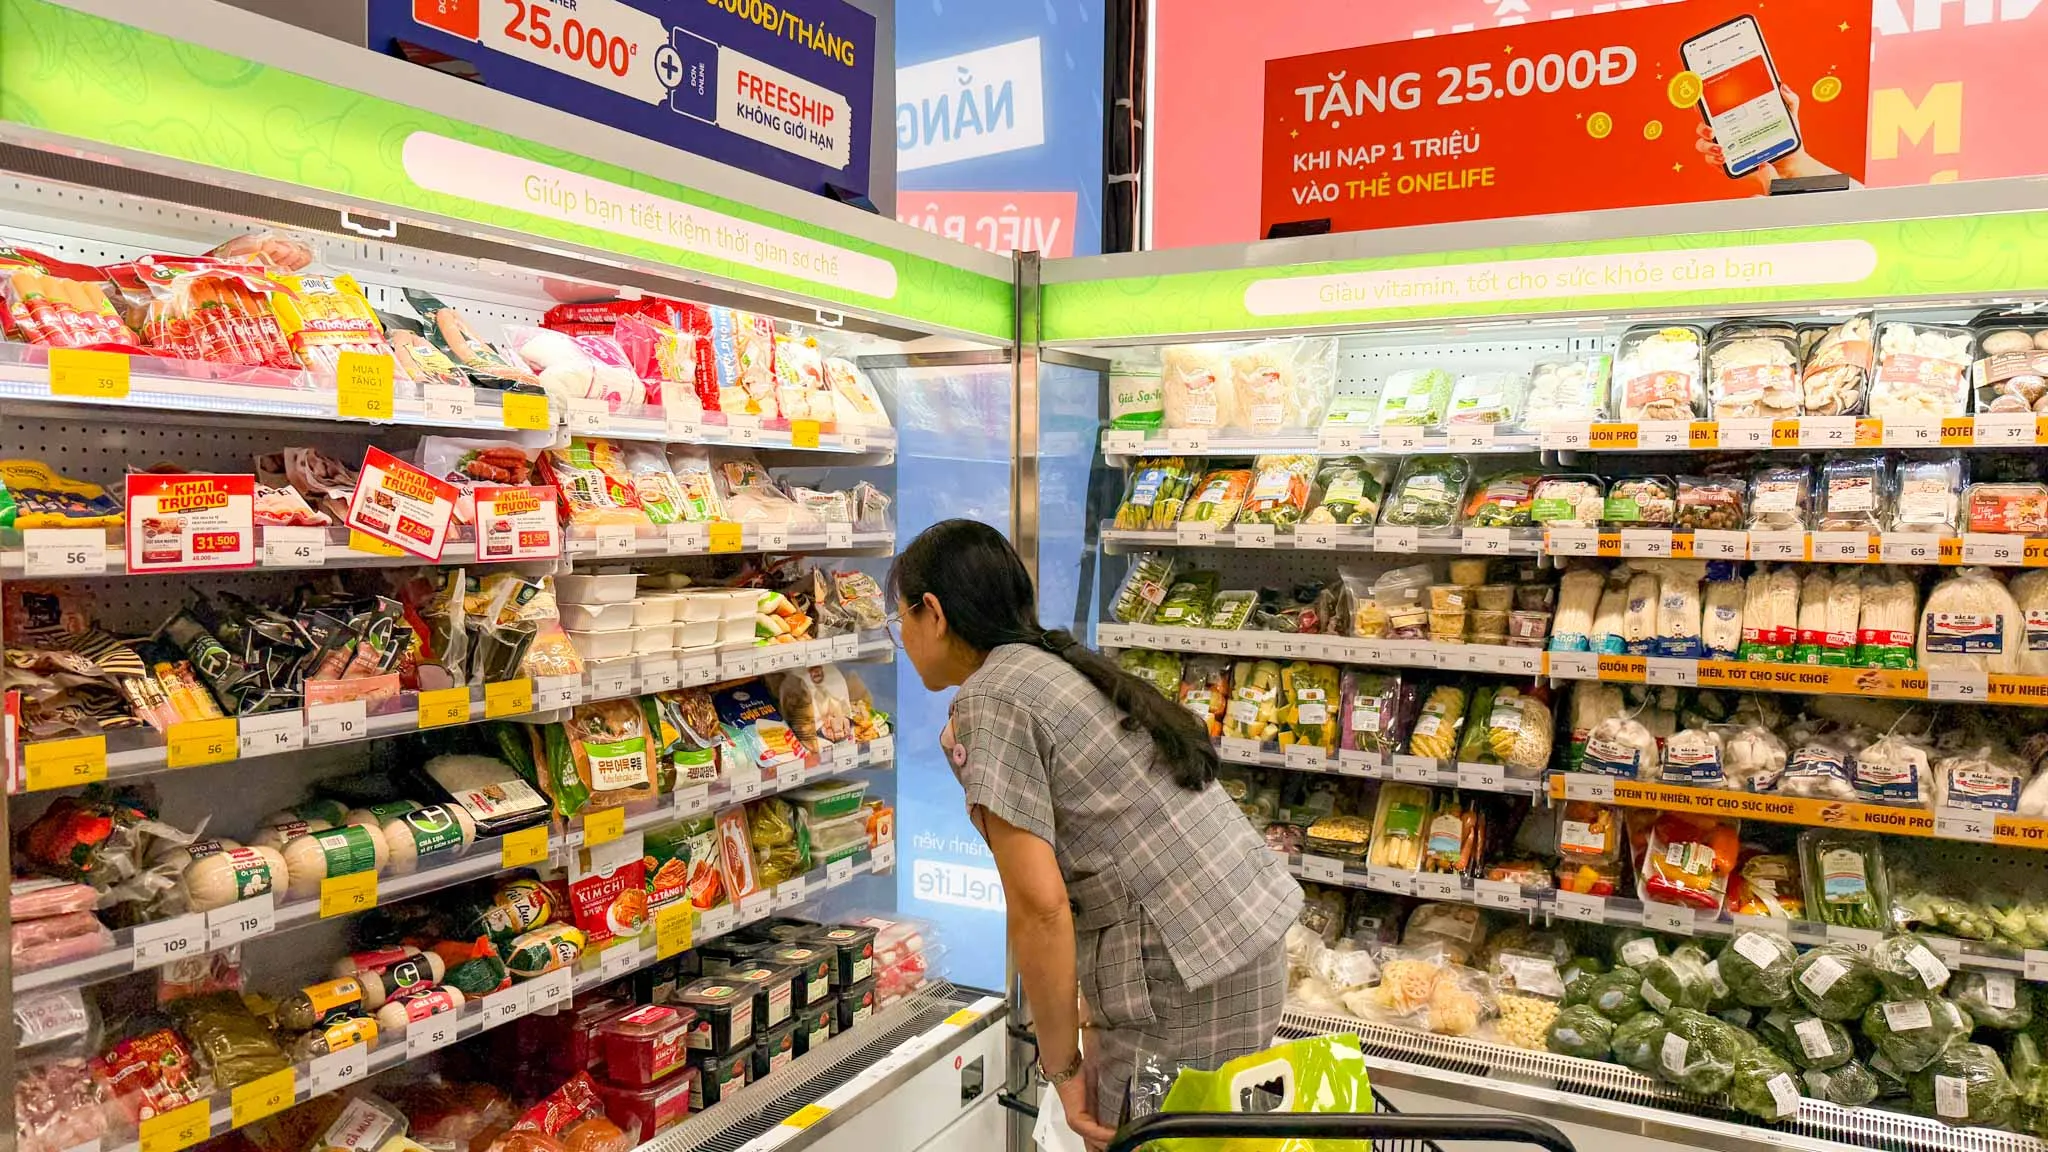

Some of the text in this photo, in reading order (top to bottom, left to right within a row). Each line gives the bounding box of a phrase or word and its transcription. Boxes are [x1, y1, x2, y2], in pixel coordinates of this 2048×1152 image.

[706, 0, 855, 67] .000Đ/THÁNG
[1294, 70, 1422, 129] TẶNG
[1436, 45, 1637, 107] 25.000Đ
[737, 70, 834, 128] FREESHIP
[736, 104, 834, 151] KHÔNG GIỚI HẠN
[1292, 130, 1480, 173] KHI NẠP 1 TRIỆU
[1290, 166, 1496, 206] VÀO THẺ ONELIFE
[523, 174, 839, 276] Giúp bạn tiết kiệm thời gian sơ chế
[1318, 257, 1773, 304] Giàu vitamin, tốt cho sức khỏe của bạn
[352, 364, 374, 375] MUA
[366, 400, 381, 410] 62
[449, 405, 463, 416] 79
[1615, 430, 1637, 441] PRO
[1665, 433, 1678, 442] 29
[1748, 432, 1760, 441] 19
[1828, 430, 1843, 439] 22
[1915, 429, 1928, 438] 16
[2006, 428, 2022, 437] 37
[1566, 435, 1578, 444] 59
[397, 469, 428, 488] KHAI
[174, 482, 213, 496] KHAI
[383, 475, 436, 502] TRƯƠNG
[158, 492, 228, 510] TRƯƠNG
[503, 490, 529, 501] KHAI
[494, 499, 540, 513] TRƯƠNG
[400, 519, 431, 538] 27.500
[196, 535, 237, 550] 31.500
[1487, 541, 1499, 549] 37
[1574, 542, 1587, 550] 29
[1647, 543, 1660, 551] 29
[294, 546, 310, 558] 45
[1720, 545, 1734, 553] 36
[1778, 545, 1792, 553] 75
[1841, 545, 1855, 554] 89
[1910, 547, 1925, 556] 69
[1994, 549, 2009, 558] 59
[66, 552, 86, 564] 56
[1576, 665, 1587, 673] 14
[1677, 672, 1685, 680] 11
[1749, 669, 1772, 681] CHO
[1901, 678, 1929, 691] NGU
[1959, 685, 1974, 694] 29
[340, 722, 352, 732] 10
[273, 732, 288, 744] 14
[207, 744, 222, 754] 56
[73, 764, 90, 775] 52
[1480, 776, 1494, 785] 30
[1717, 797, 1740, 809] CHO
[1909, 815, 1934, 828] PRO
[1964, 824, 1980, 833] 34
[580, 879, 625, 903] KIMCHI
[1579, 907, 1592, 916] 27
[239, 918, 258, 932] 119
[1668, 918, 1681, 927] 39
[164, 937, 188, 953] 109
[1855, 943, 1868, 951] 19
[545, 984, 561, 997] 123
[501, 1002, 517, 1016] 109
[431, 1030, 444, 1042] 55
[338, 1064, 354, 1078] 49
